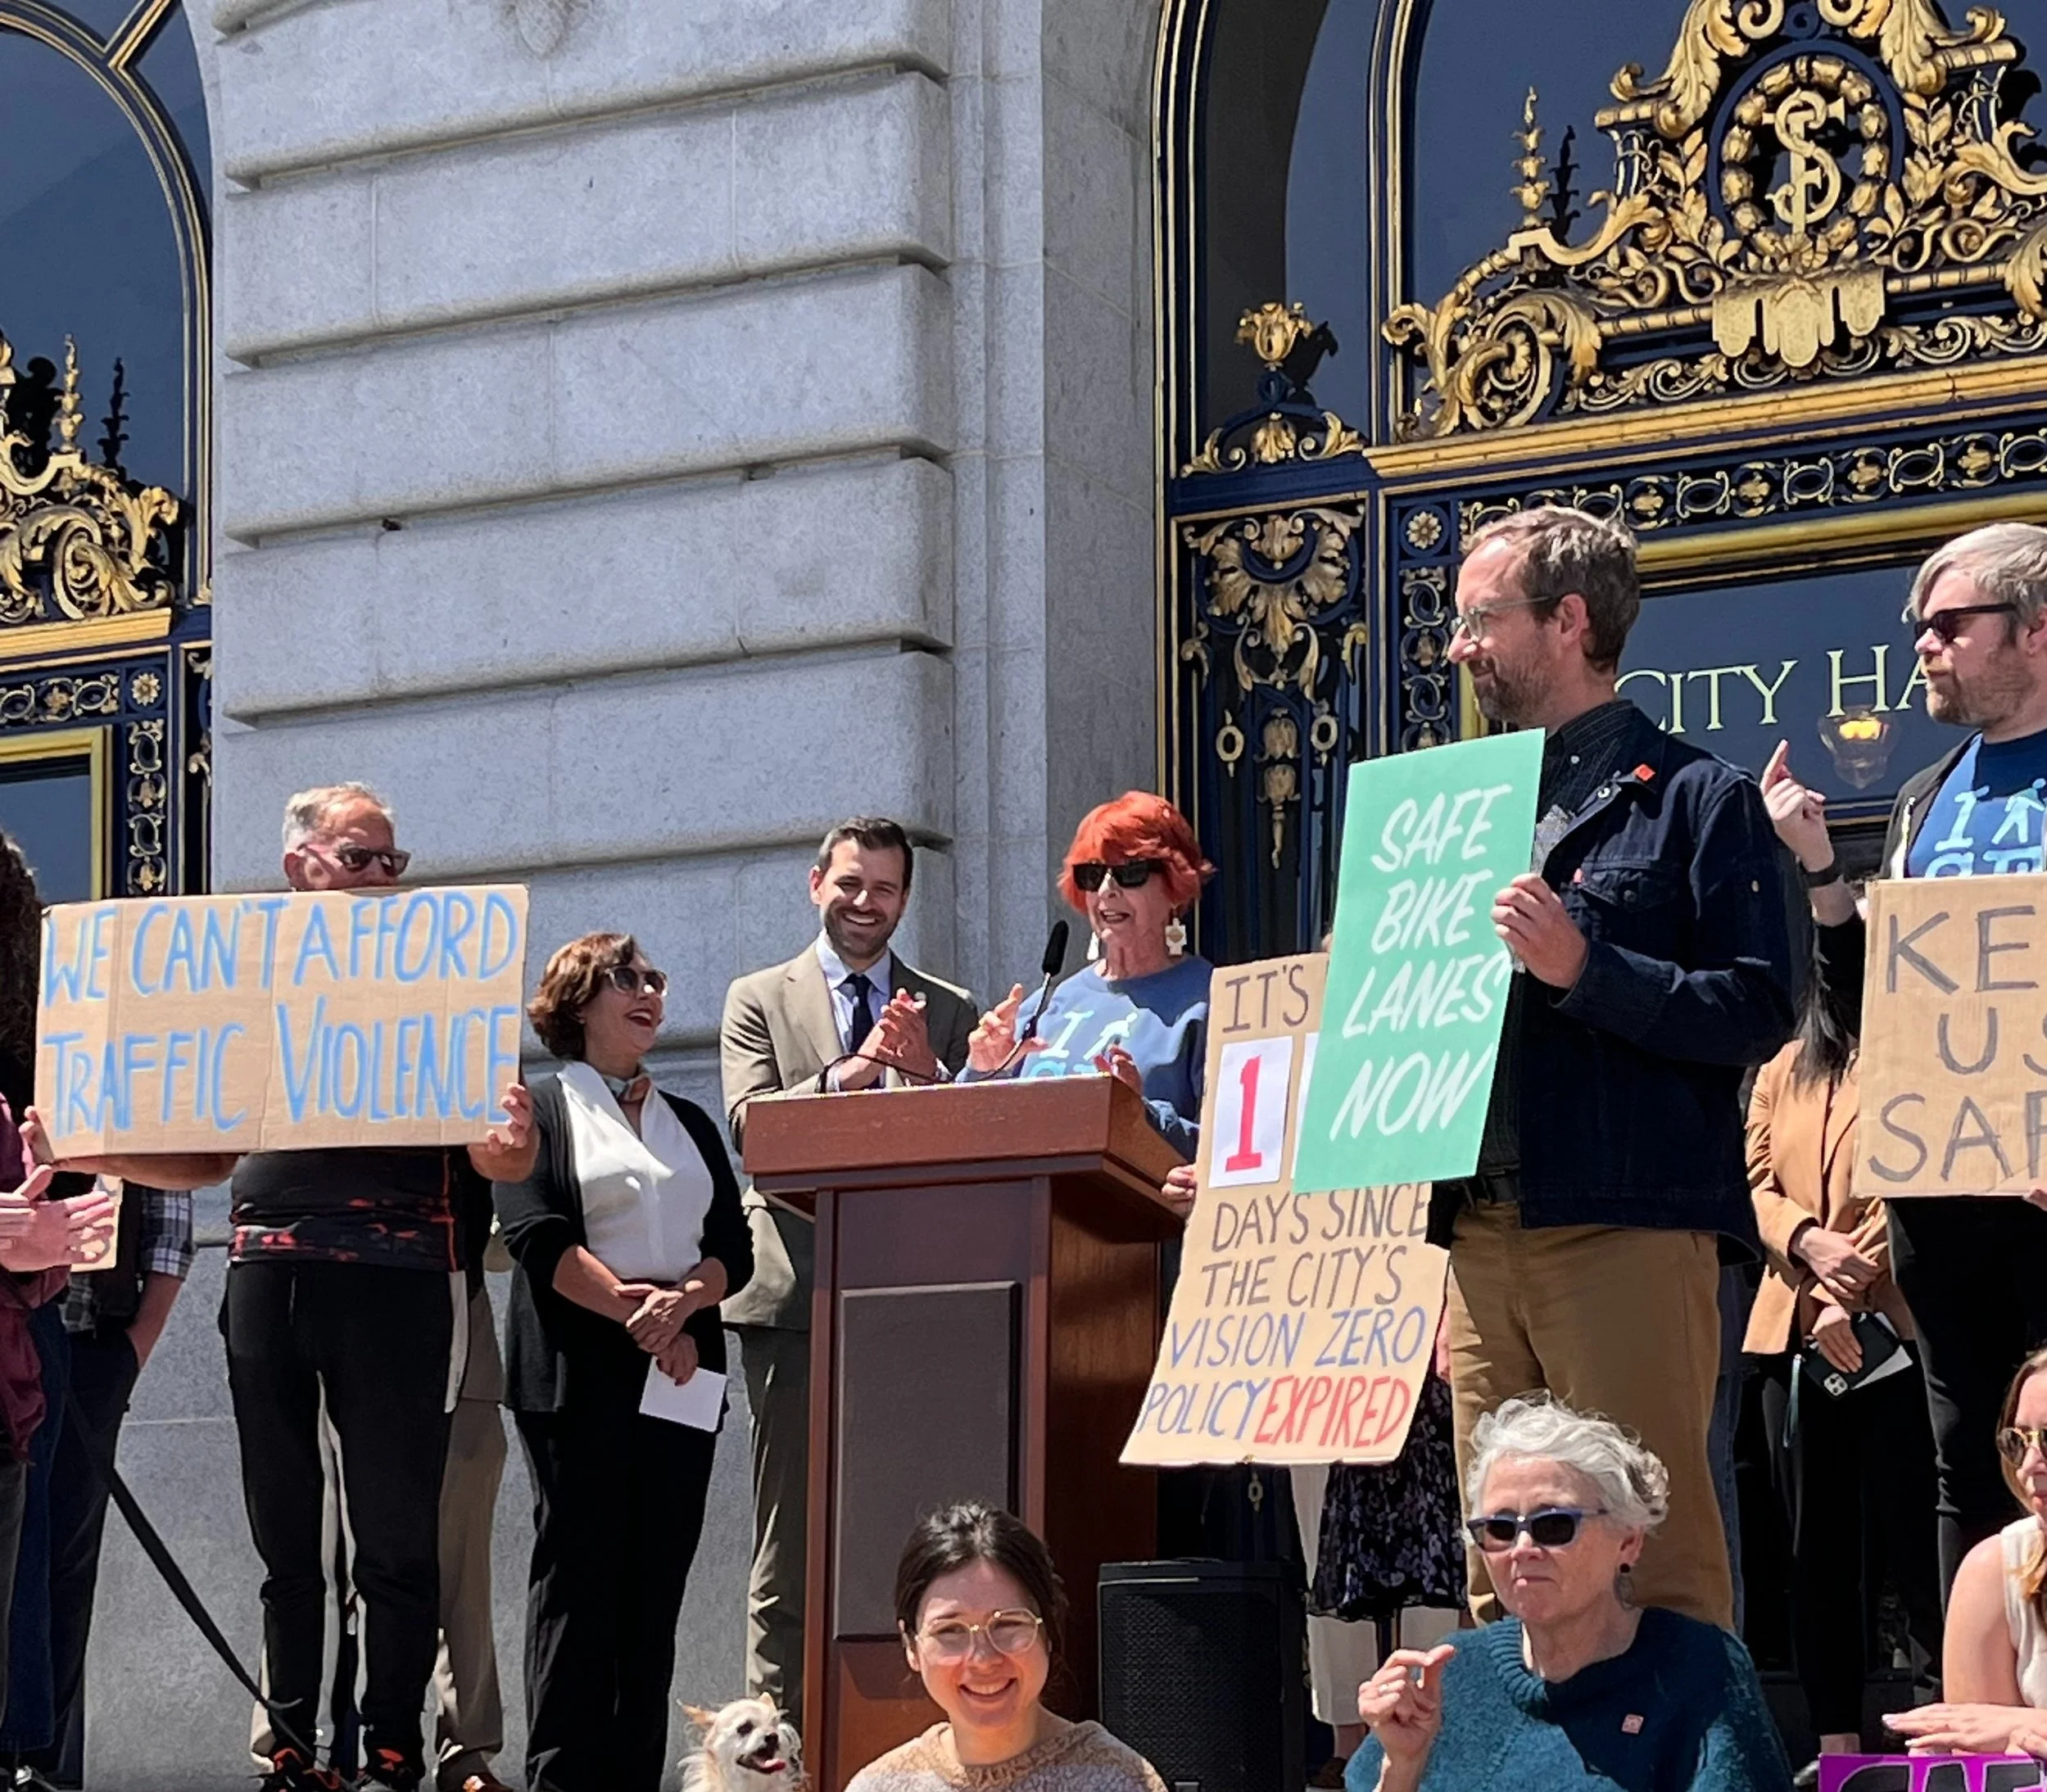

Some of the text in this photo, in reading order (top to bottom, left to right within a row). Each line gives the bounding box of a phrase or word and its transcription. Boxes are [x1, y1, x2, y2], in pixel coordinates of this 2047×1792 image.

[1615, 660, 1798, 735] CITY
[1370, 784, 1513, 873] SAFE
[43, 891, 519, 1008] WE CAN'T AFFORD
[1371, 870, 1493, 953] BIKE
[1222, 964, 1309, 1034] IT'S
[1342, 953, 1511, 1039] LANES
[42, 994, 519, 1139] TRAFFIC VIOLENCE
[1329, 1043, 1496, 1141] NOW
[1225, 1055, 1262, 1172] 1
[1211, 1182, 1429, 1252] DAYS SINCE
[1202, 1244, 1408, 1309] THE CITY'S
[1171, 1306, 1426, 1369] VISION ZERO
[1137, 1374, 1411, 1449] POLICY EXPIRED
